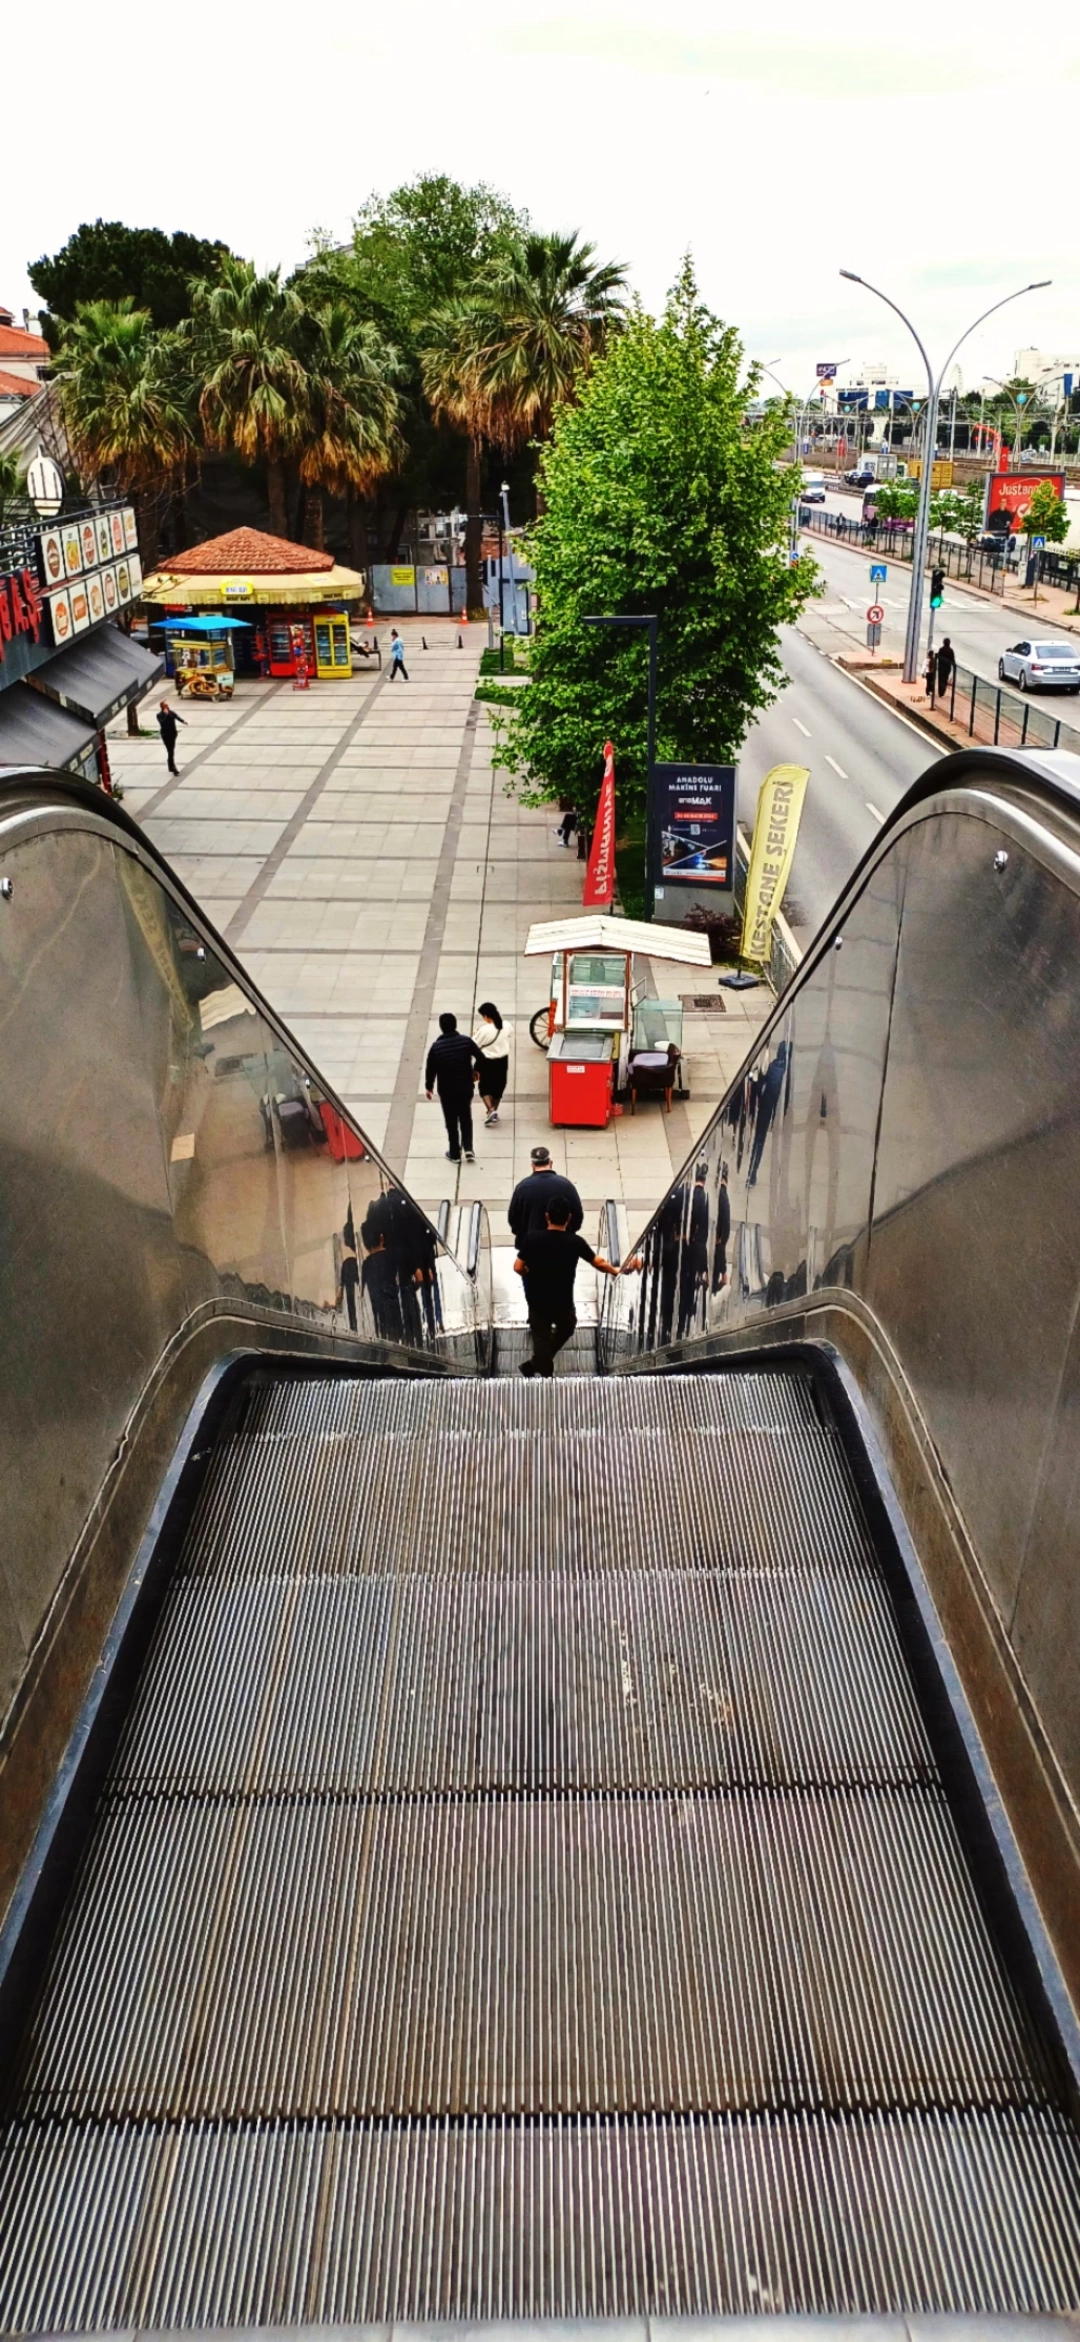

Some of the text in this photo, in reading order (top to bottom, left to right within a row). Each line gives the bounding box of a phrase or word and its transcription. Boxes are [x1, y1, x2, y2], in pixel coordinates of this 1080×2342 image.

[676, 776, 714, 784] ANADOLU
[668, 783, 722, 792] MAKİNE FUARI
[750, 780, 794, 955] KESTANE ŞEKERİ
